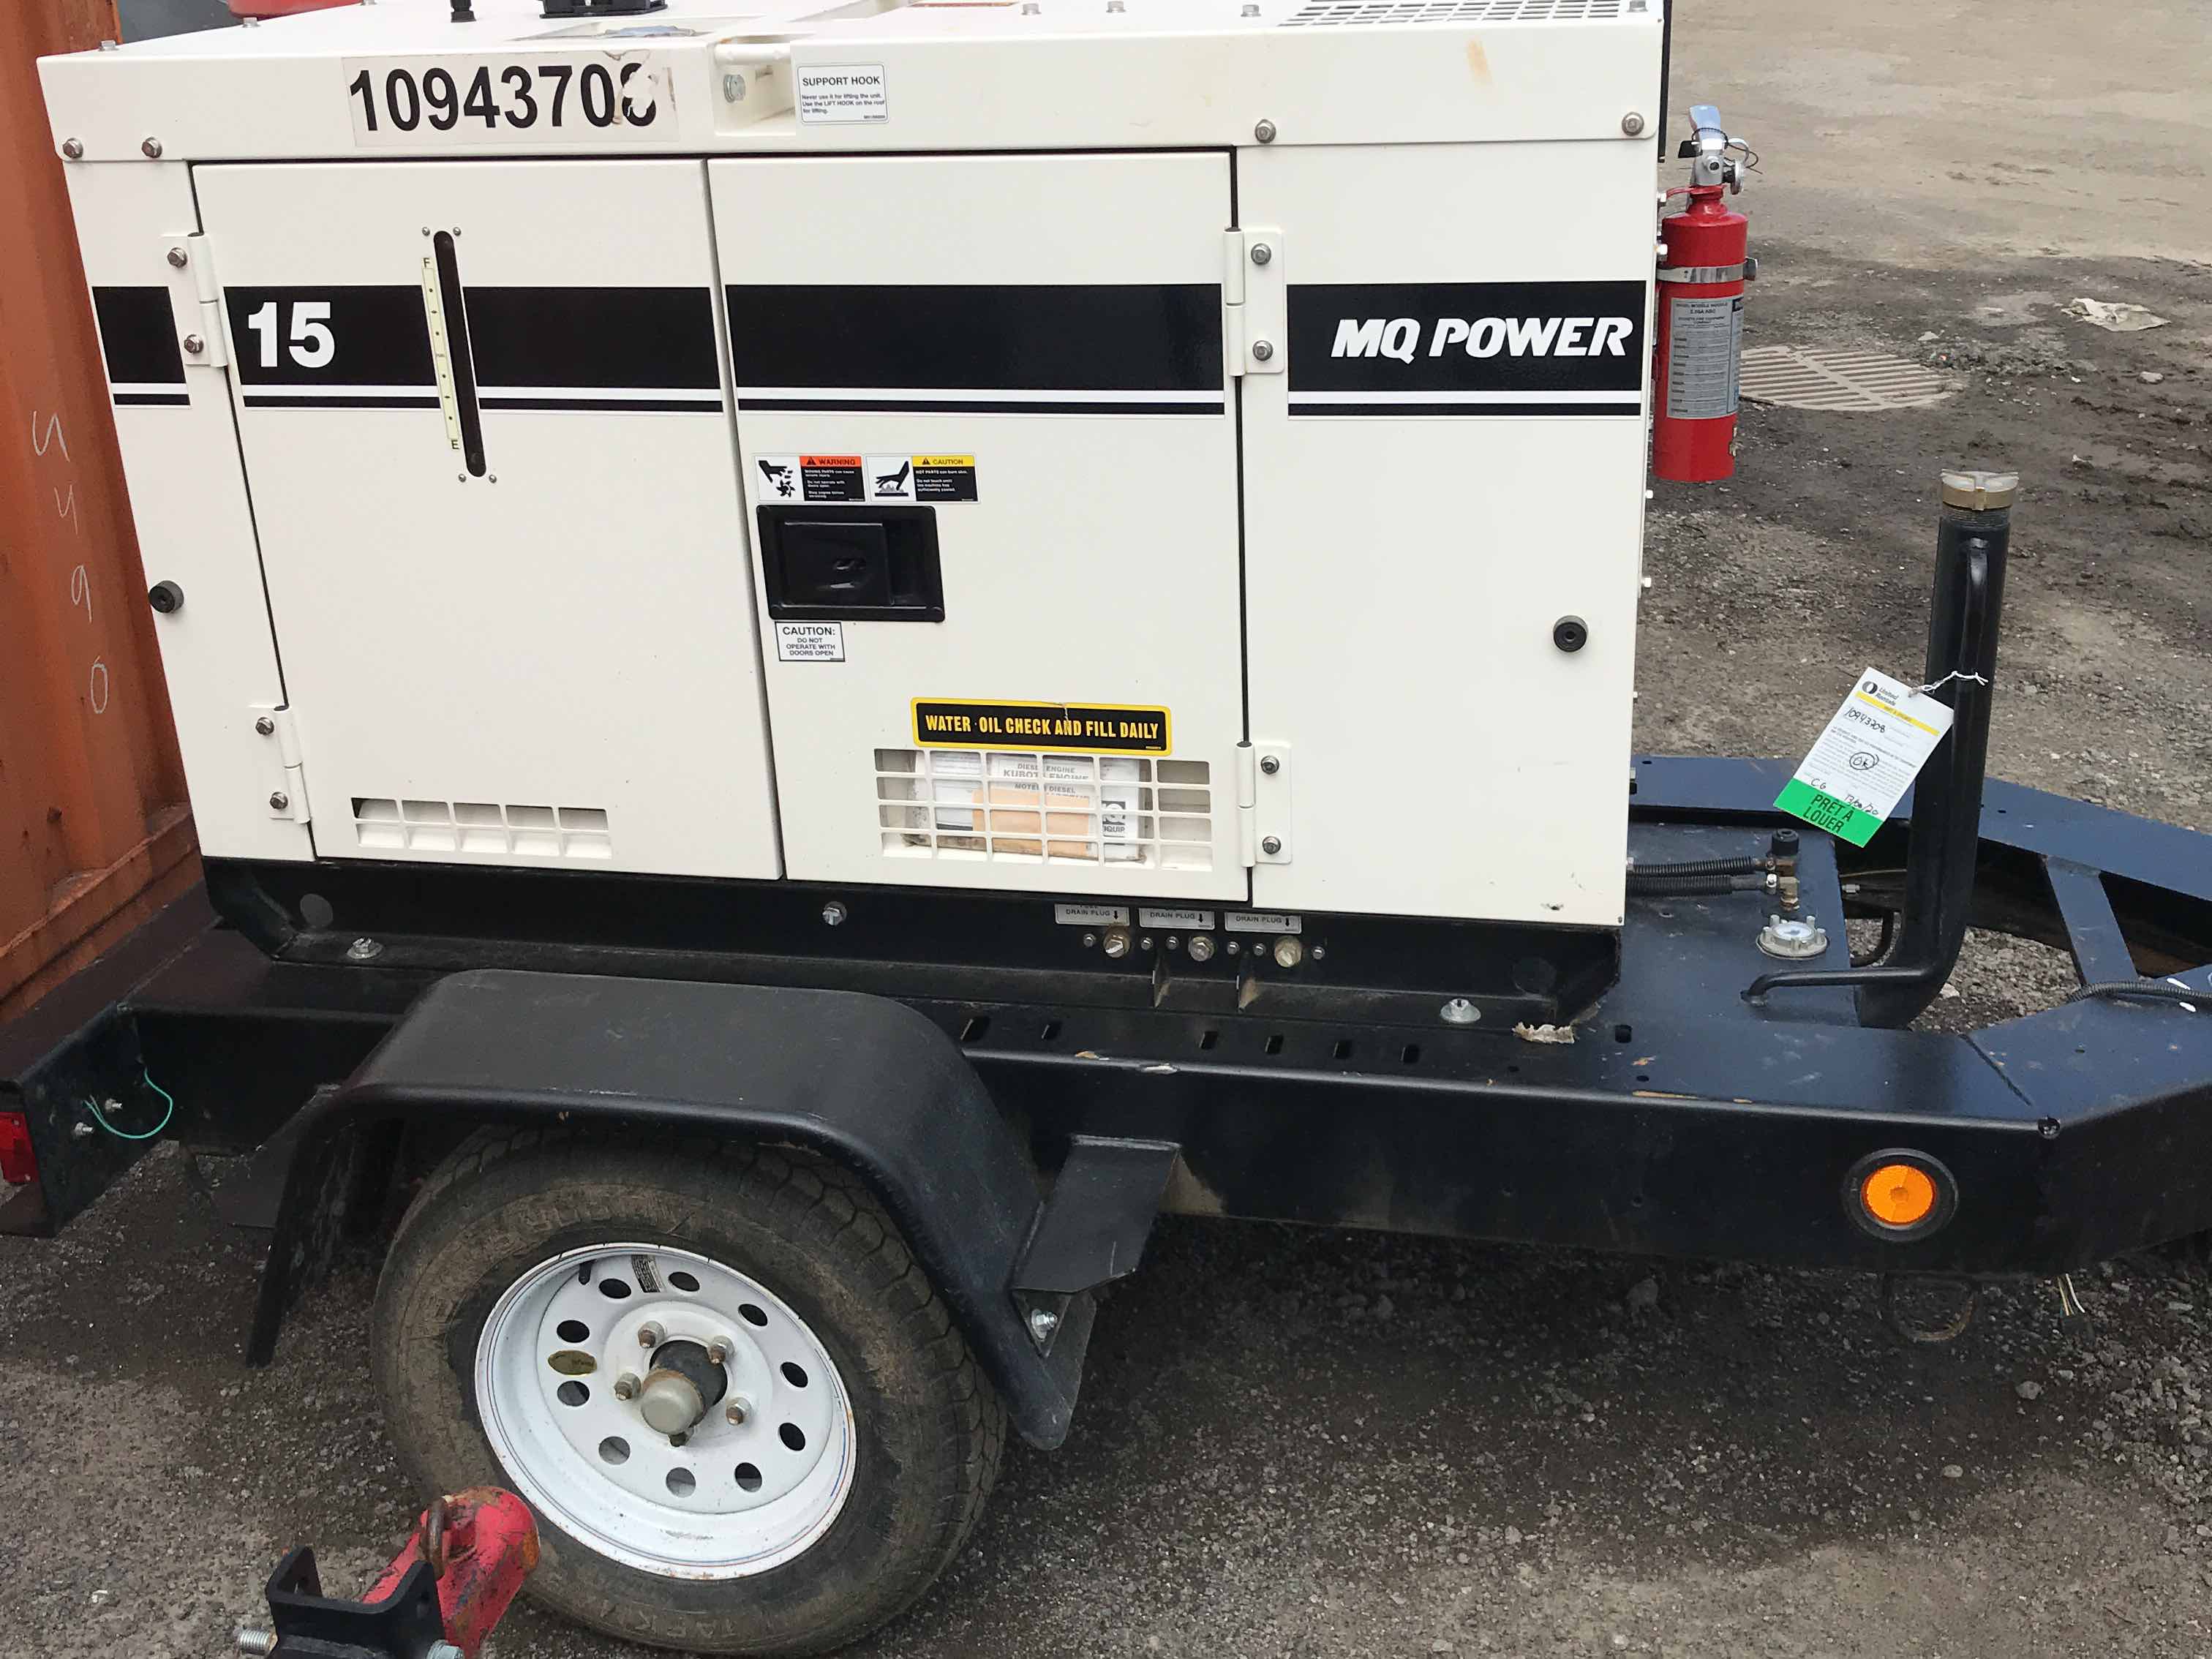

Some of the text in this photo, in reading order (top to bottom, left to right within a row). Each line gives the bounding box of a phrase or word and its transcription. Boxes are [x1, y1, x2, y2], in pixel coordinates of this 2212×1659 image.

[802, 76, 881, 86] SUPPORT HOOK
[423, 257, 430, 268] F
[248, 302, 335, 368] 15
[1331, 317, 1633, 364] MQ POWER
[451, 440, 459, 450] E
[783, 626, 835, 636] CAUTION:
[925, 715, 1159, 739] WATER OIL CHECK AND FILL DAILY
[1046, 765, 1076, 773] ENGINE
[1049, 786, 1076, 794] DIESEL
[1802, 806, 1844, 834] LOUER
